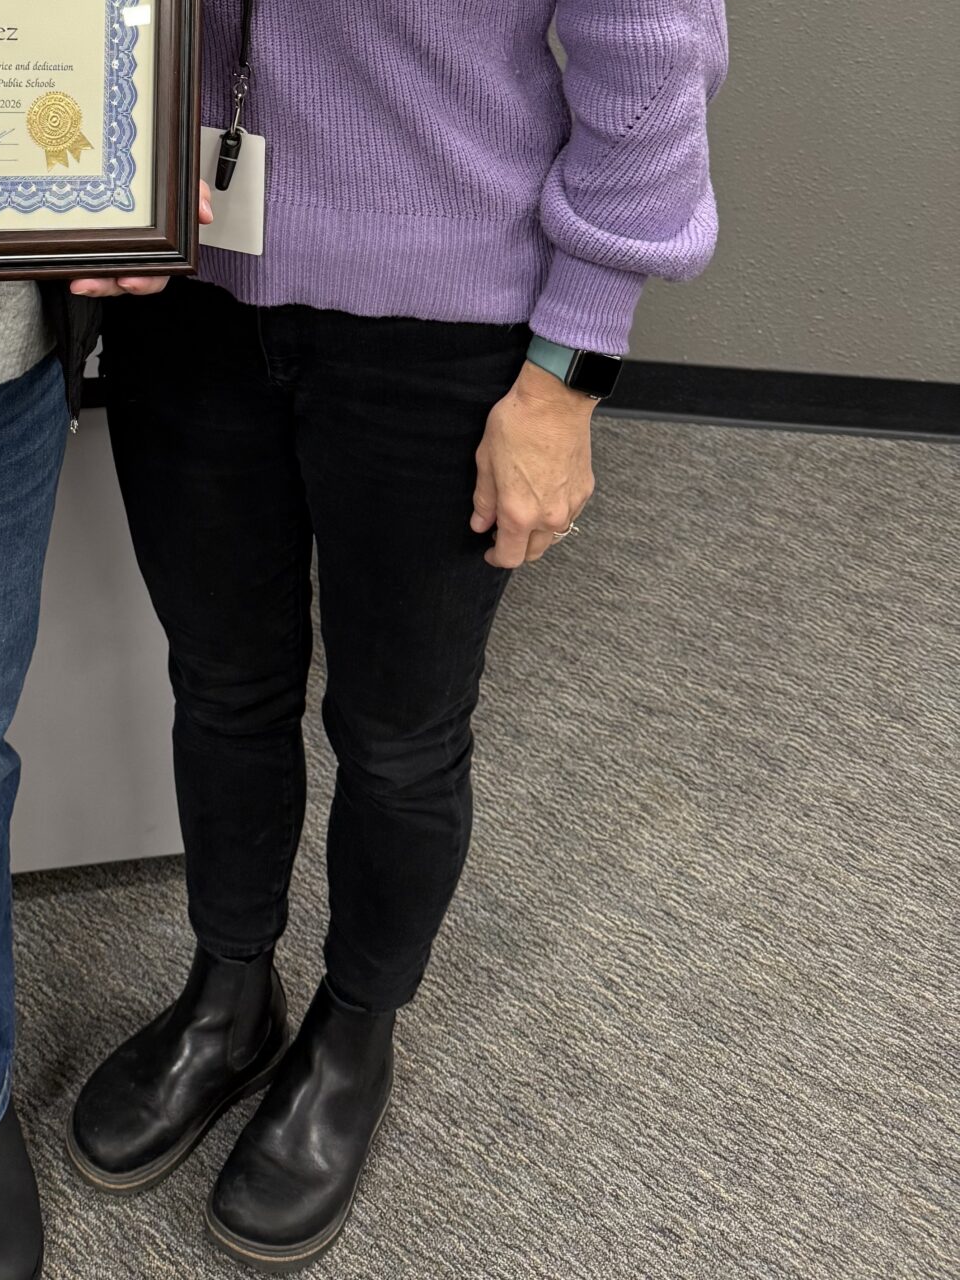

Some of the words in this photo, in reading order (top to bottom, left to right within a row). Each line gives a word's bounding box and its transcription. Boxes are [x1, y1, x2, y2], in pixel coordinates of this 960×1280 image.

[15, 61, 31, 71] and
[32, 61, 74, 72] dedication
[25, 78, 56, 88] Schools
[0, 100, 22, 109] 2026
